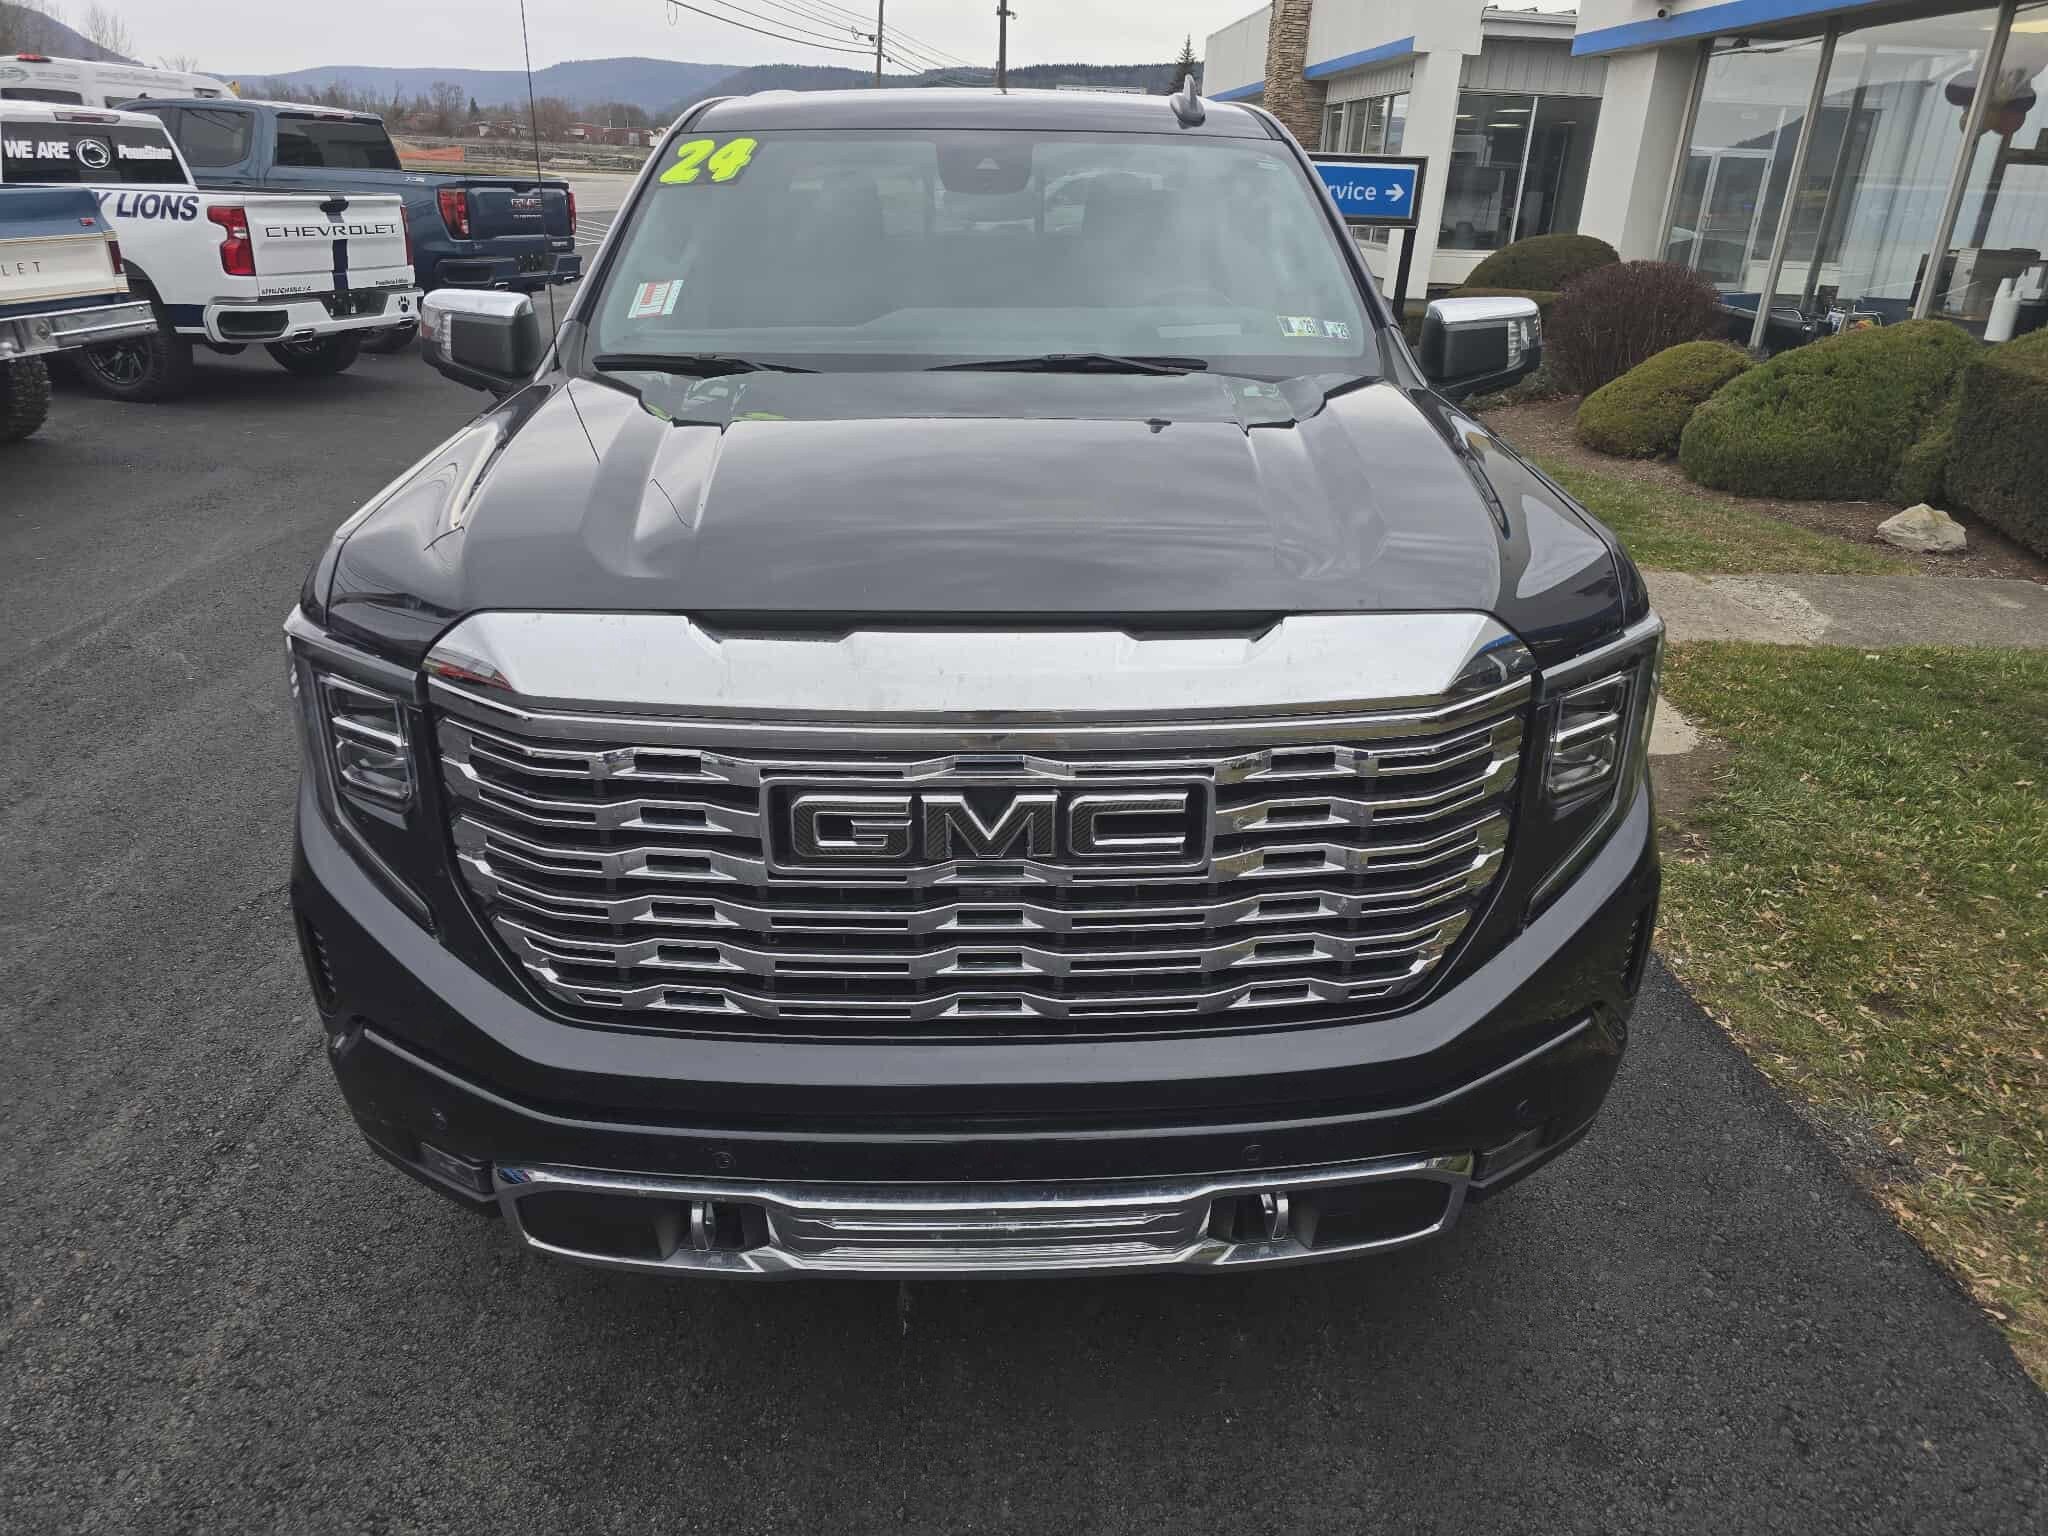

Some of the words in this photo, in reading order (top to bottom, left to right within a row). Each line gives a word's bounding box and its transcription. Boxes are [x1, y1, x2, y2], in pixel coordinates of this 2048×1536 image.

[4, 140, 33, 159] WE
[37, 142, 70, 159] ARE
[660, 138, 758, 184] 24
[116, 193, 199, 221] LIONS
[265, 224, 397, 238] CHEVROLET
[791, 794, 1188, 858] GMC
